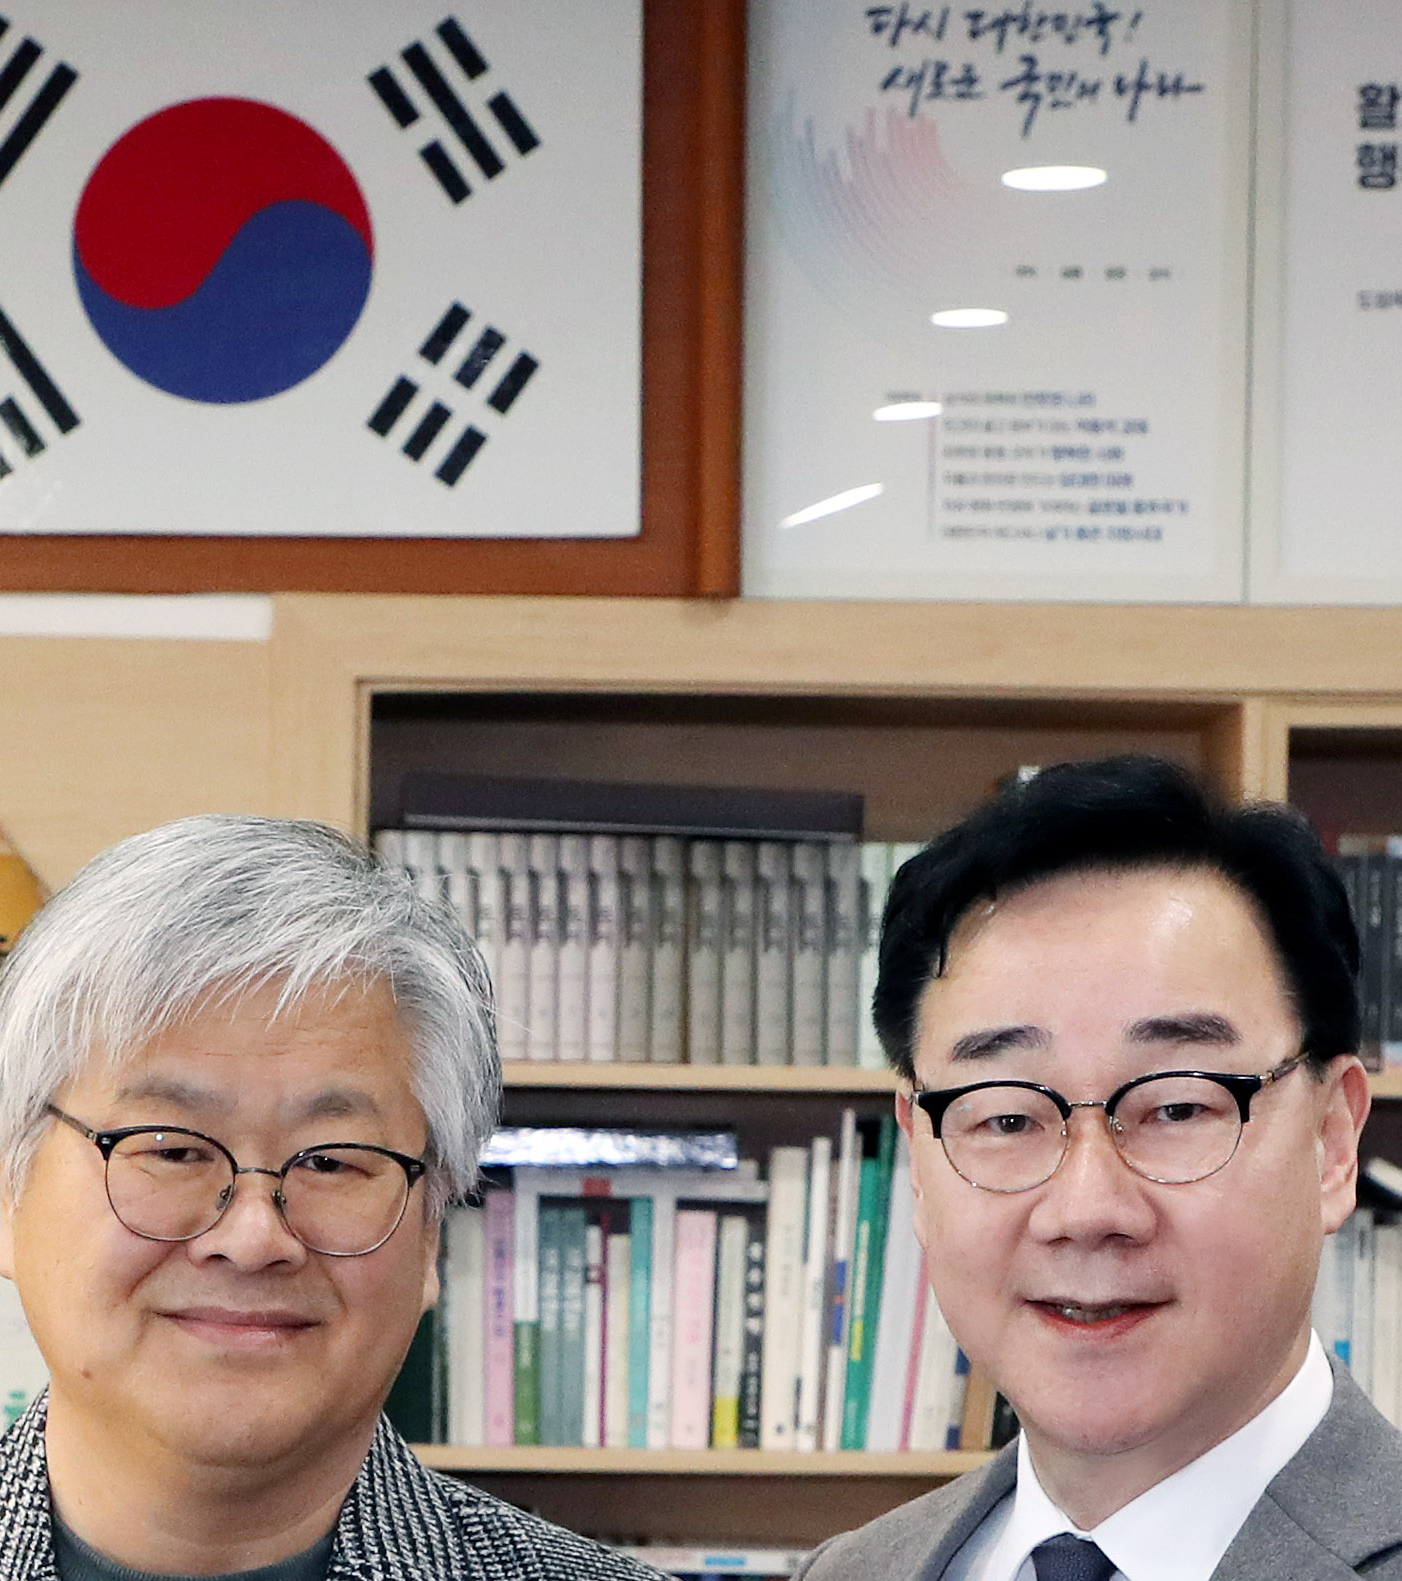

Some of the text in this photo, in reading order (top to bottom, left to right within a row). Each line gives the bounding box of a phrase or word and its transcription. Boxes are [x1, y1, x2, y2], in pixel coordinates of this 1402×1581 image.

[865, 0, 1144, 55] 다시 대한민국!
[1000, 54, 1102, 140] 국민의
[1113, 60, 1206, 124] 나라
